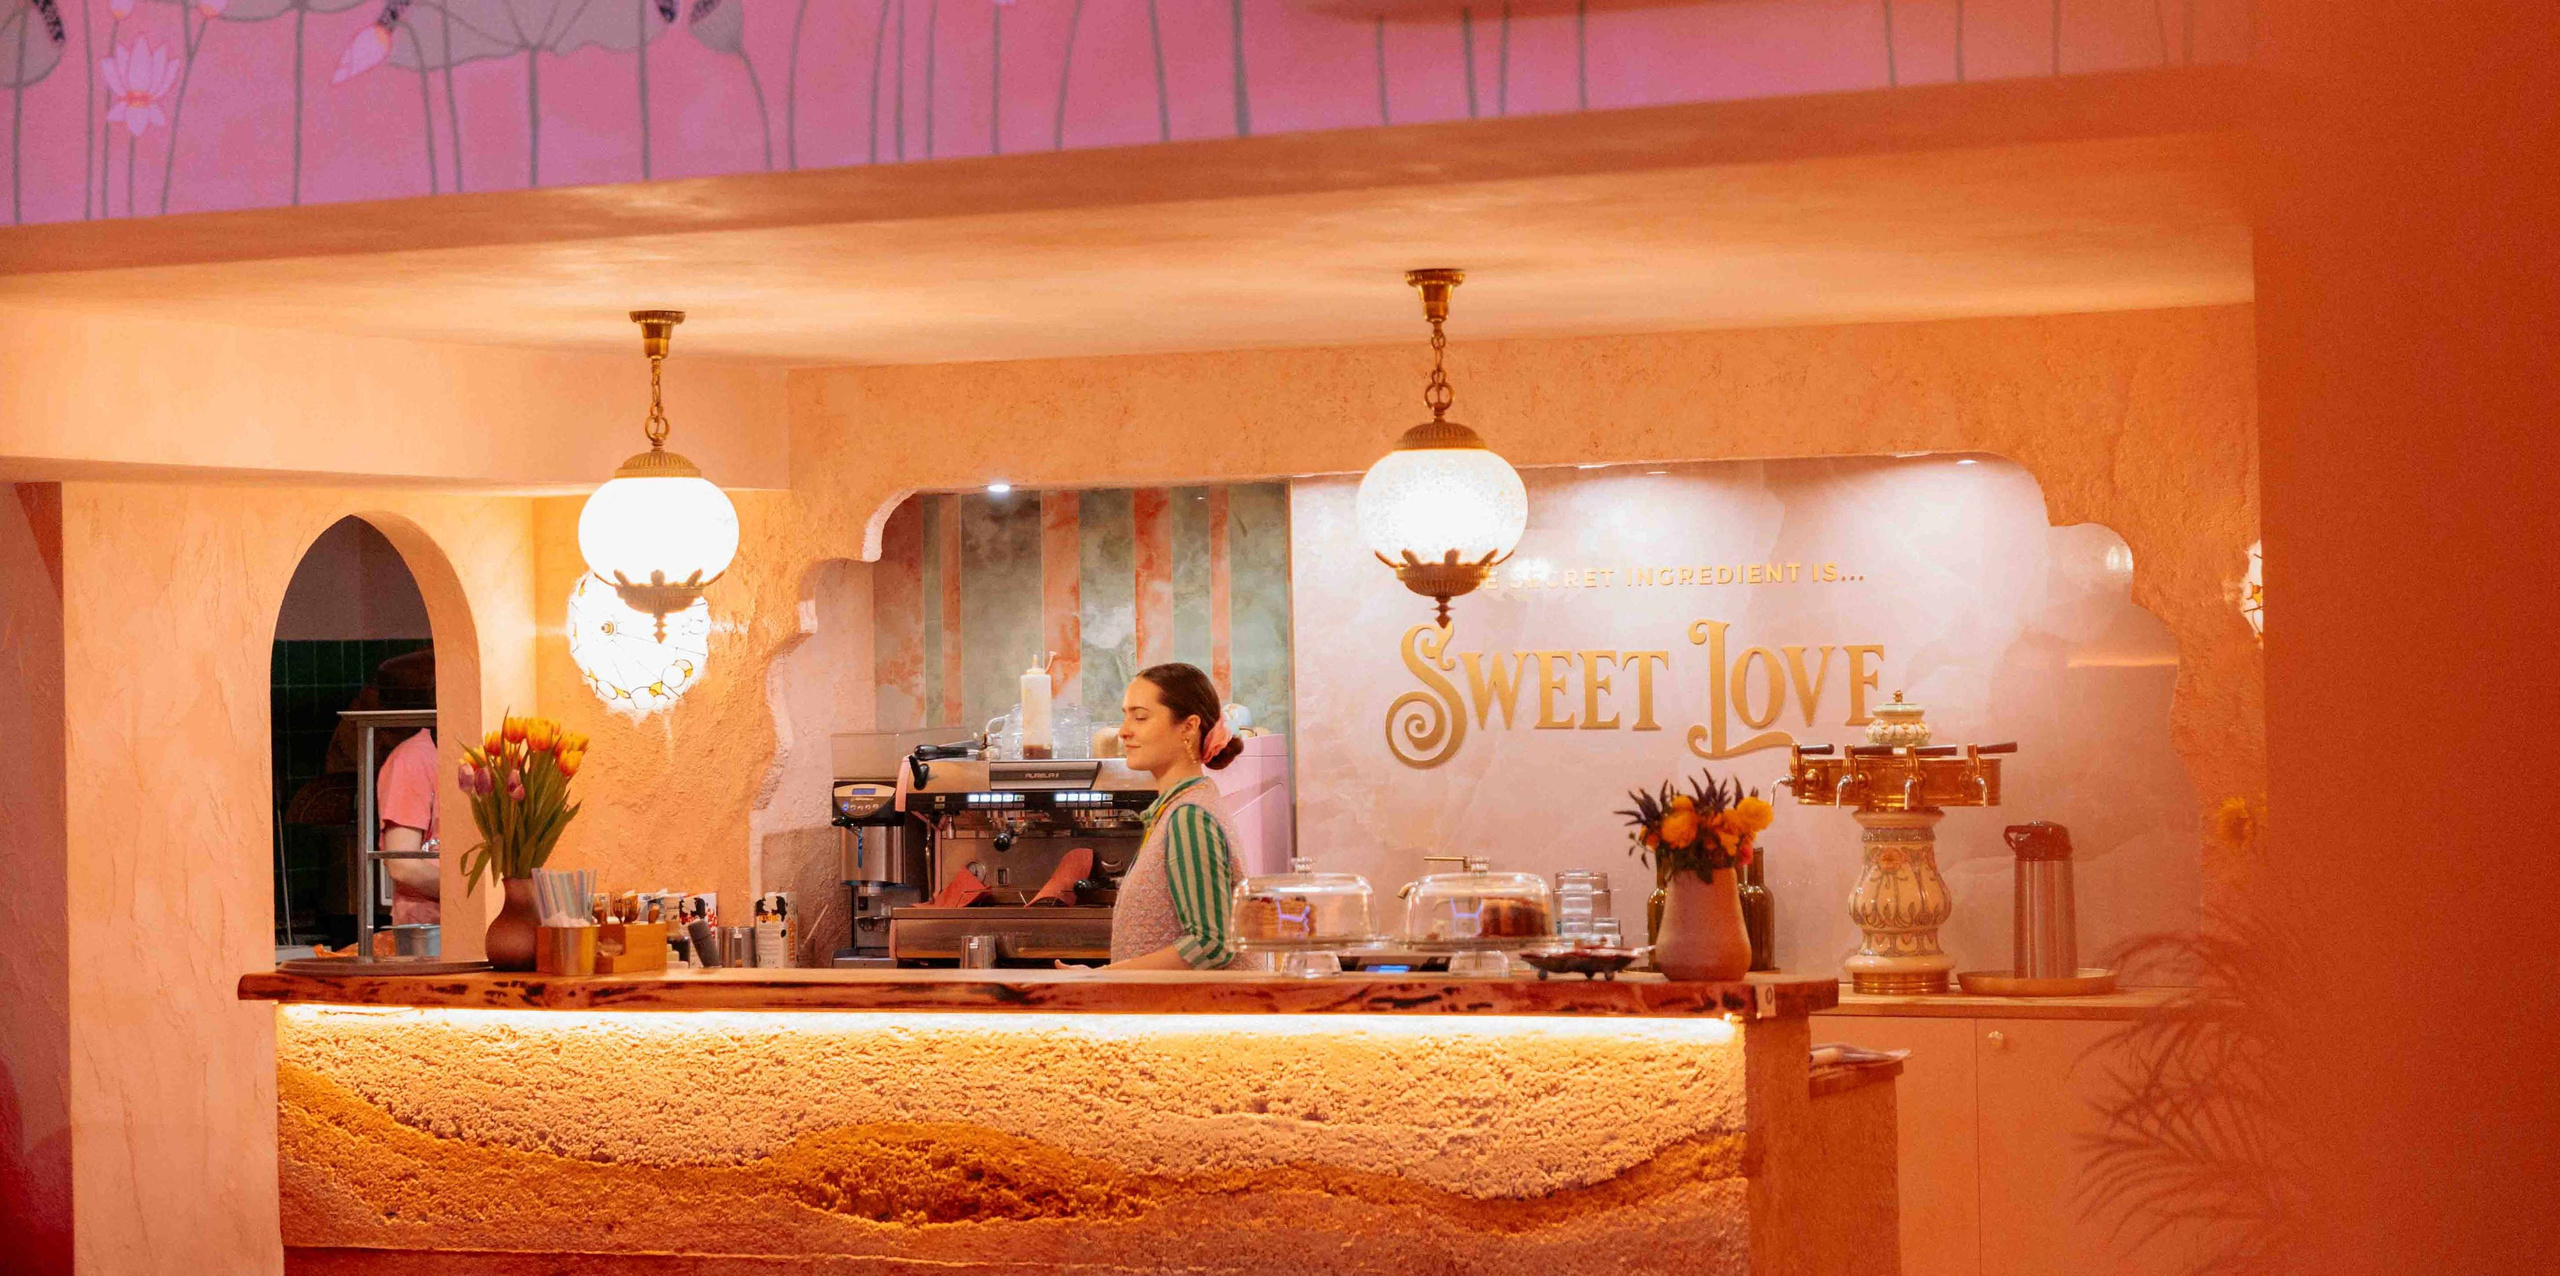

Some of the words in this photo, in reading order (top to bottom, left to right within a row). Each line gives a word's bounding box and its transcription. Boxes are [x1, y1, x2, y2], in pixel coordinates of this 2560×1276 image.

[1626, 562, 1801, 587] INGREDIENT
[1812, 561, 1865, 584] IS...
[1385, 621, 1669, 769] SWEET
[1687, 619, 1884, 760] LOVE
